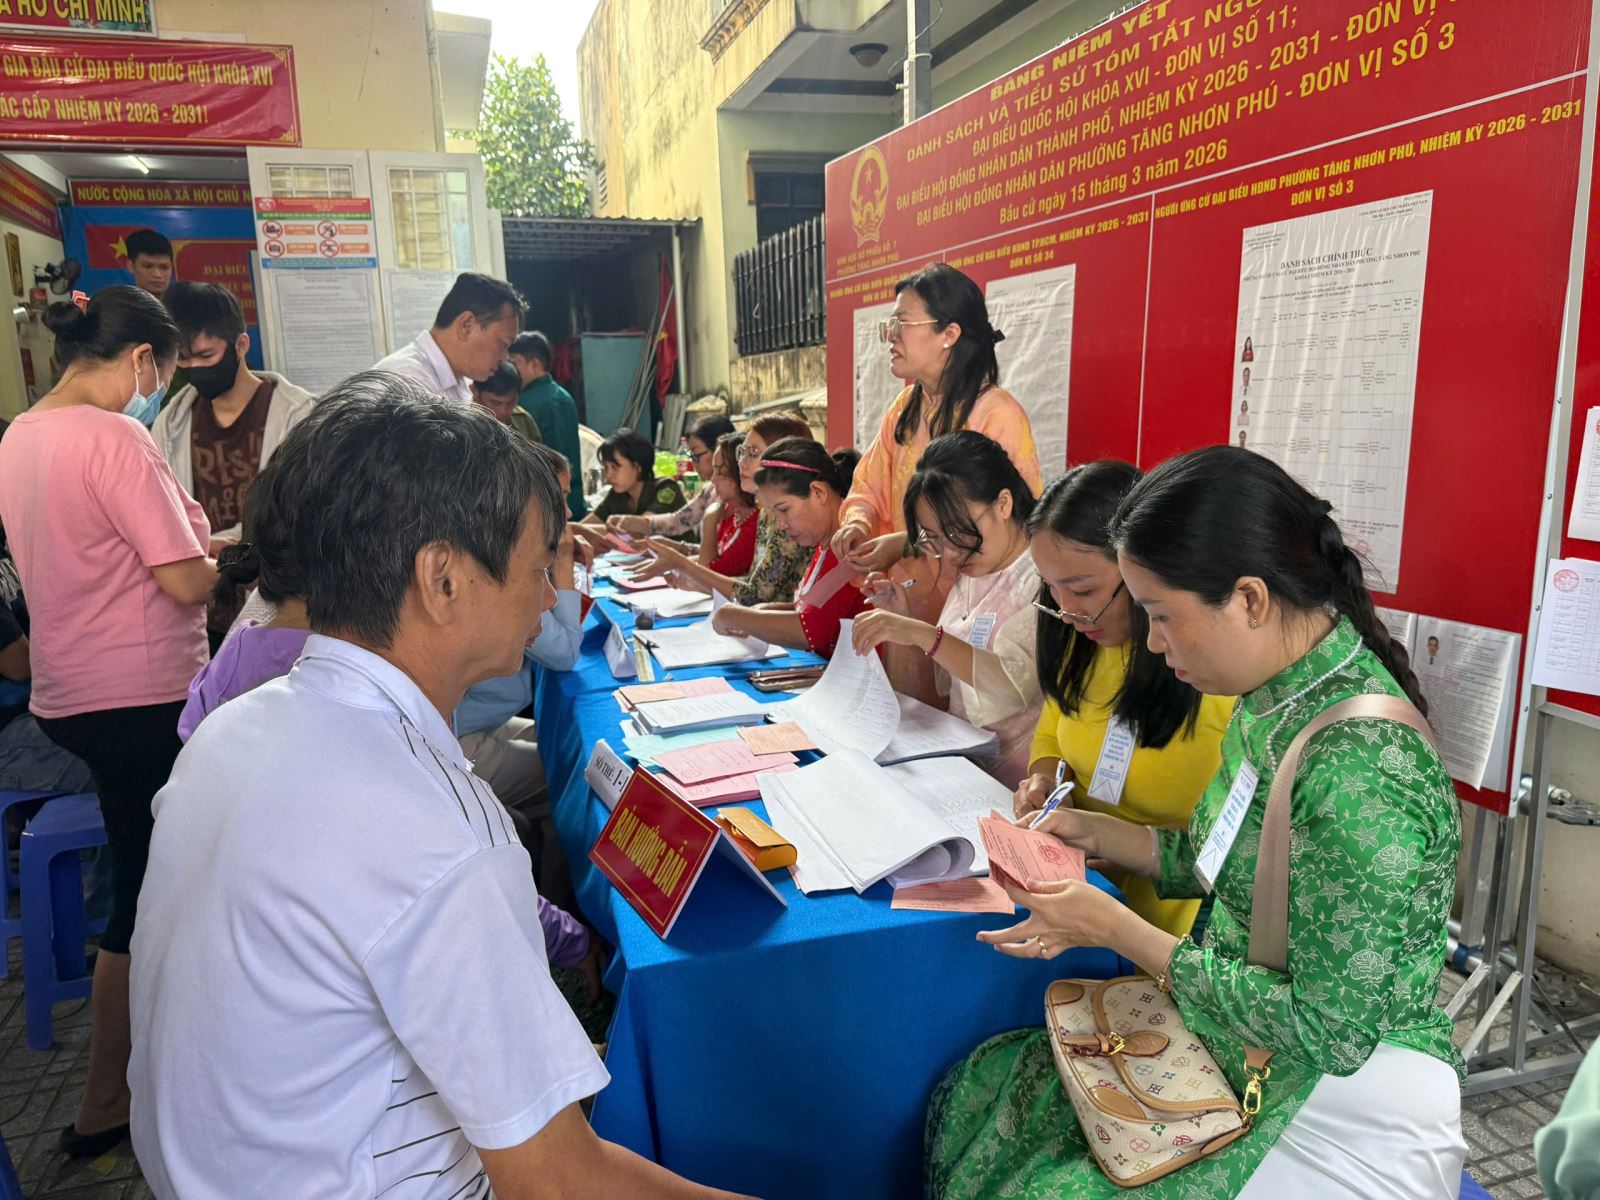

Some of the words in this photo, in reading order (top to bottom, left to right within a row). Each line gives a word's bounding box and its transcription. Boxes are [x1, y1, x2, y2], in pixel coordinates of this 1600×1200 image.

[1122, 0, 1172, 36] YẾT
[2, 55, 29, 77] GIA
[86, 59, 110, 82] ĐẠI
[113, 53, 145, 80] BIỂU
[149, 56, 184, 82] QUỐC
[188, 60, 210, 87] HỘI
[213, 61, 249, 84] KHÓA
[252, 65, 273, 86] XVI
[907, 135, 941, 163] DANH
[946, 115, 983, 144] SÁCH
[989, 103, 1010, 125] VÀ
[1014, 84, 1053, 113] TIỂU
[1059, 64, 1088, 93] SỬ
[1093, 43, 1140, 78] TÓM
[1149, 16, 1195, 52] TẮT
[973, 138, 990, 157] ĐẠI
[992, 123, 1016, 149] BIỂU
[1020, 106, 1052, 137] QUỐC
[1056, 96, 1078, 122] HỘI
[1082, 79, 1120, 112] KHÓA
[1124, 66, 1150, 94] XVI
[1165, 42, 1202, 77] ĐƠN
[1208, 32, 1226, 60] VỊ
[1232, 9, 1260, 49] SỐ
[1266, 5, 1298, 34] 11;
[22, 90, 50, 119] CẤP
[55, 95, 101, 125] NHIỆM
[104, 97, 122, 122] KỲ
[126, 102, 159, 123] 2026
[896, 193, 910, 211] ĐẠI
[911, 179, 930, 205] BIỂU
[932, 178, 947, 201] HỘI
[949, 165, 976, 192] ĐỒNG
[978, 157, 1007, 182] NHÂN
[1010, 146, 1033, 168] DÂN
[1036, 131, 1078, 158] THÀNH
[1082, 107, 1114, 142] PHỐ,
[1119, 90, 1170, 128] NHIỆM
[1176, 76, 1199, 106] KỲ
[1203, 59, 1249, 97] 2026
[1269, 30, 1320, 72] 2031
[1346, 0, 1402, 41] ĐƠN
[917, 208, 931, 226] ĐẠI
[933, 197, 952, 221] BIỂU
[955, 191, 971, 214] HỘI
[973, 181, 1002, 205] ĐỒNG
[1005, 168, 1036, 196] NHÂN
[1040, 161, 1065, 185] DÂN
[1068, 141, 1127, 176] PHƯỜNG
[1131, 122, 1173, 154] TĂNG
[1178, 101, 1230, 139] NHƠN
[1235, 80, 1278, 120] PHÚ
[1299, 59, 1350, 98] ĐƠN
[1358, 47, 1382, 79] VỊ
[1391, 20, 1431, 67] SỐ
[1438, 22, 1456, 51] 3
[999, 203, 1019, 225] Bầu
[1022, 199, 1037, 216] cử
[1039, 190, 1067, 215] ngày
[1070, 182, 1086, 204] 15
[1090, 174, 1127, 197] tháng
[1132, 165, 1141, 185] 3
[1146, 157, 1179, 181] năm
[1184, 138, 1228, 171] 2026
[1155, 203, 1178, 219] NGƯỜI
[1199, 192, 1211, 208] CỬ
[1212, 191, 1227, 206] ĐẠI
[1229, 182, 1249, 202] BIỂU
[1250, 178, 1277, 196] HĐND
[1279, 166, 1320, 190] PHƯỜNG
[1323, 158, 1351, 179] TĂNG
[1353, 147, 1386, 171] NHƠN
[1389, 142, 1416, 162] PHÚ,
[1419, 130, 1462, 154] NHIỆM
[1465, 122, 1484, 143] KỲ
[1487, 113, 1527, 137] 2026
[1541, 98, 1581, 124] 2031
[78, 185, 110, 201] NƯỚC
[113, 186, 145, 204] CỘNG
[148, 187, 171, 201] HÒA
[175, 186, 190, 202] XÃ
[194, 186, 213, 204] HỘI
[216, 185, 239, 202] CHỦ
[1291, 189, 1312, 206] ĐƠN
[1314, 187, 1326, 203] VỊ
[1328, 178, 1343, 198] SỐ
[1346, 179, 1354, 193] 3
[1059, 225, 1083, 242] NHIỆM
[1097, 218, 1119, 233] 2026
[1126, 210, 1149, 226] 2031
[1281, 260, 1301, 270] DANH
[1301, 255, 1321, 266] SÁCH
[1322, 250, 1348, 263] CHÍNH
[1350, 247, 1373, 259] THỨC
[608, 805, 639, 857] BÀN
[628, 825, 667, 878] HƯỚNG
[653, 839, 688, 898] DẪN
